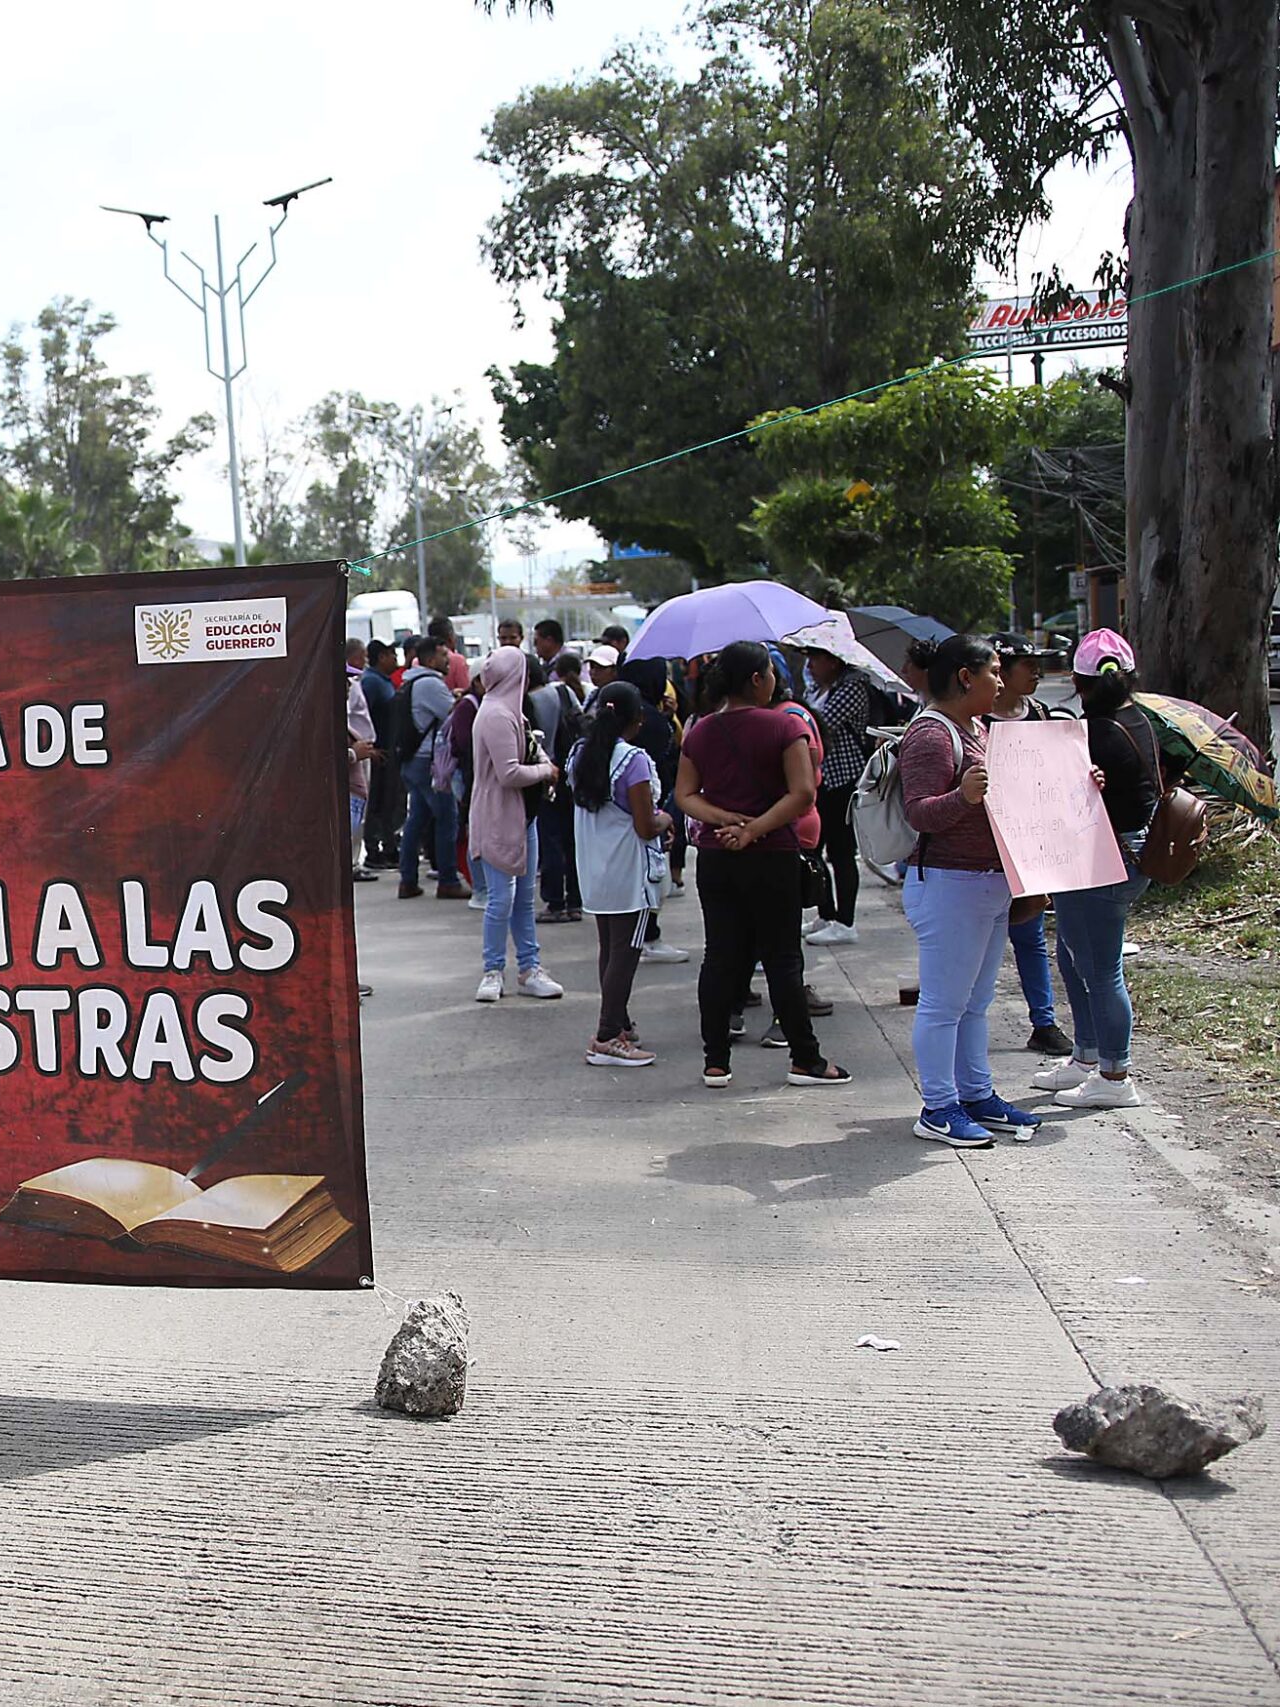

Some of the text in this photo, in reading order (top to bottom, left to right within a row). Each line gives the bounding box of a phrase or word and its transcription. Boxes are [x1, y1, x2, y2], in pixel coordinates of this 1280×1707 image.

[1041, 332, 1050, 344] Y
[1053, 324, 1128, 343] ACCESORIOS
[204, 613, 263, 623] SECRETARÍA DE
[205, 620, 282, 637] EDUCACIÓN
[205, 636, 276, 651] GUERRERO
[24, 704, 108, 767] DE
[36, 882, 100, 967] A
[122, 879, 295, 971] LAS
